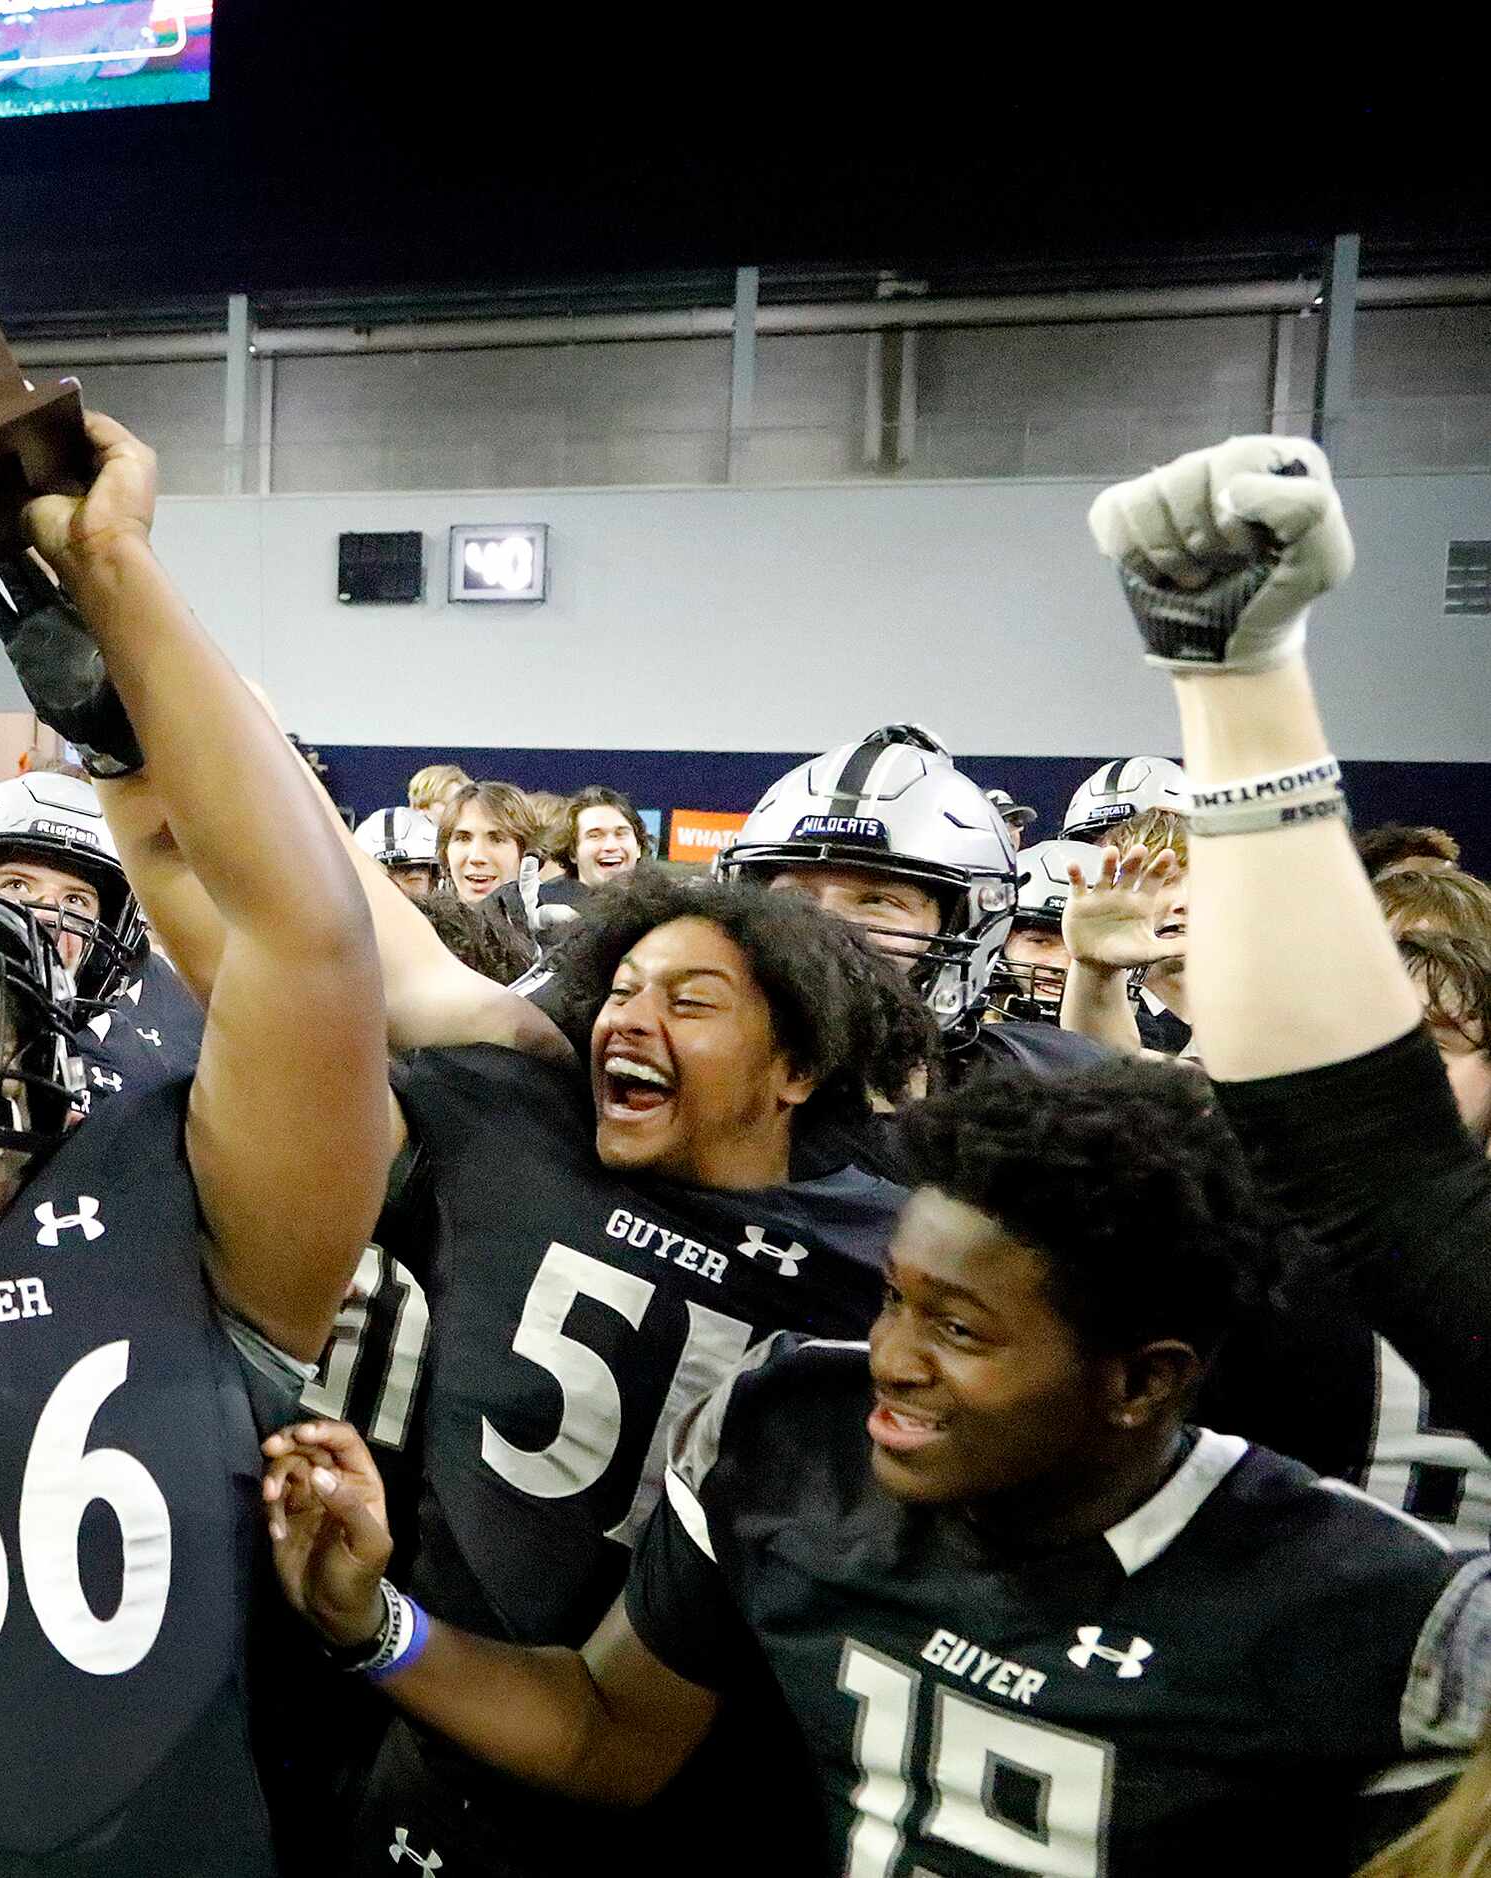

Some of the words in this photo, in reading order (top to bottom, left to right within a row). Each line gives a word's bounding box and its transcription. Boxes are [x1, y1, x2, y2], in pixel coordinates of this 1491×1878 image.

[37, 820, 97, 844] Riddell
[802, 817, 879, 836] WILDCATS
[605, 1208, 730, 1284] GUYER
[920, 1628, 1048, 1706] GUYER
